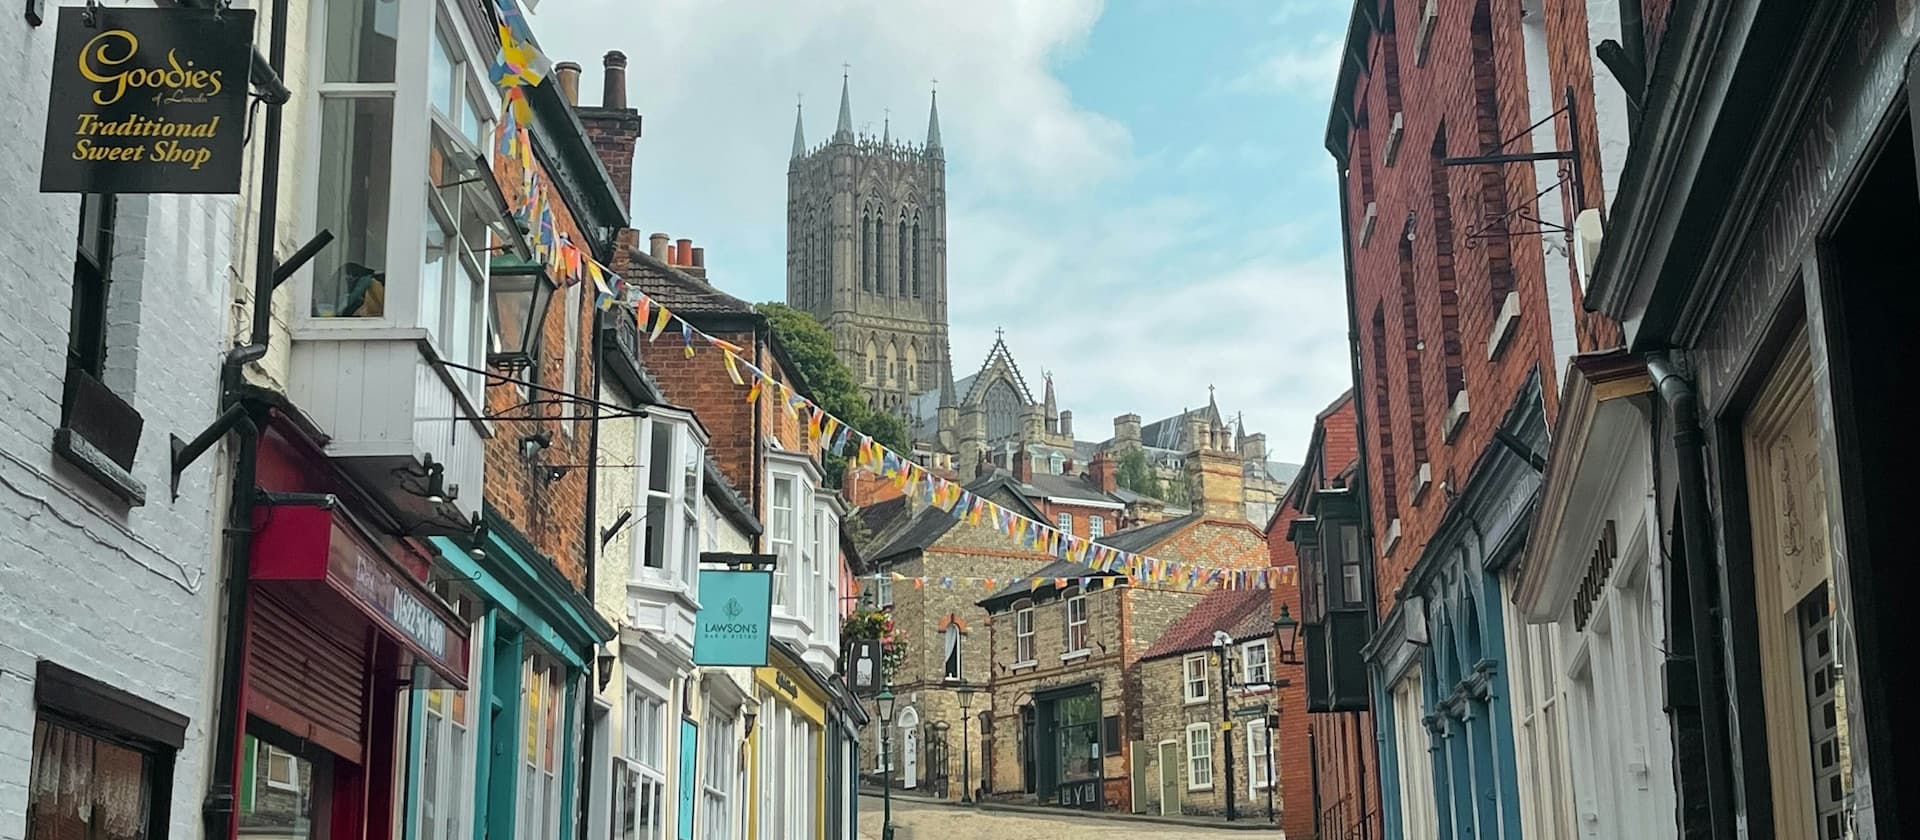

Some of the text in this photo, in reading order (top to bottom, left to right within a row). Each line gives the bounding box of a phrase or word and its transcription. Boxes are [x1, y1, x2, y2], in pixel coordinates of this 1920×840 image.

[79, 30, 222, 105] Goodies
[152, 91, 163, 109] of
[75, 114, 220, 138] Traditional
[72, 139, 211, 170] Sweet Shop
[705, 623, 758, 634] LAWSON'S
